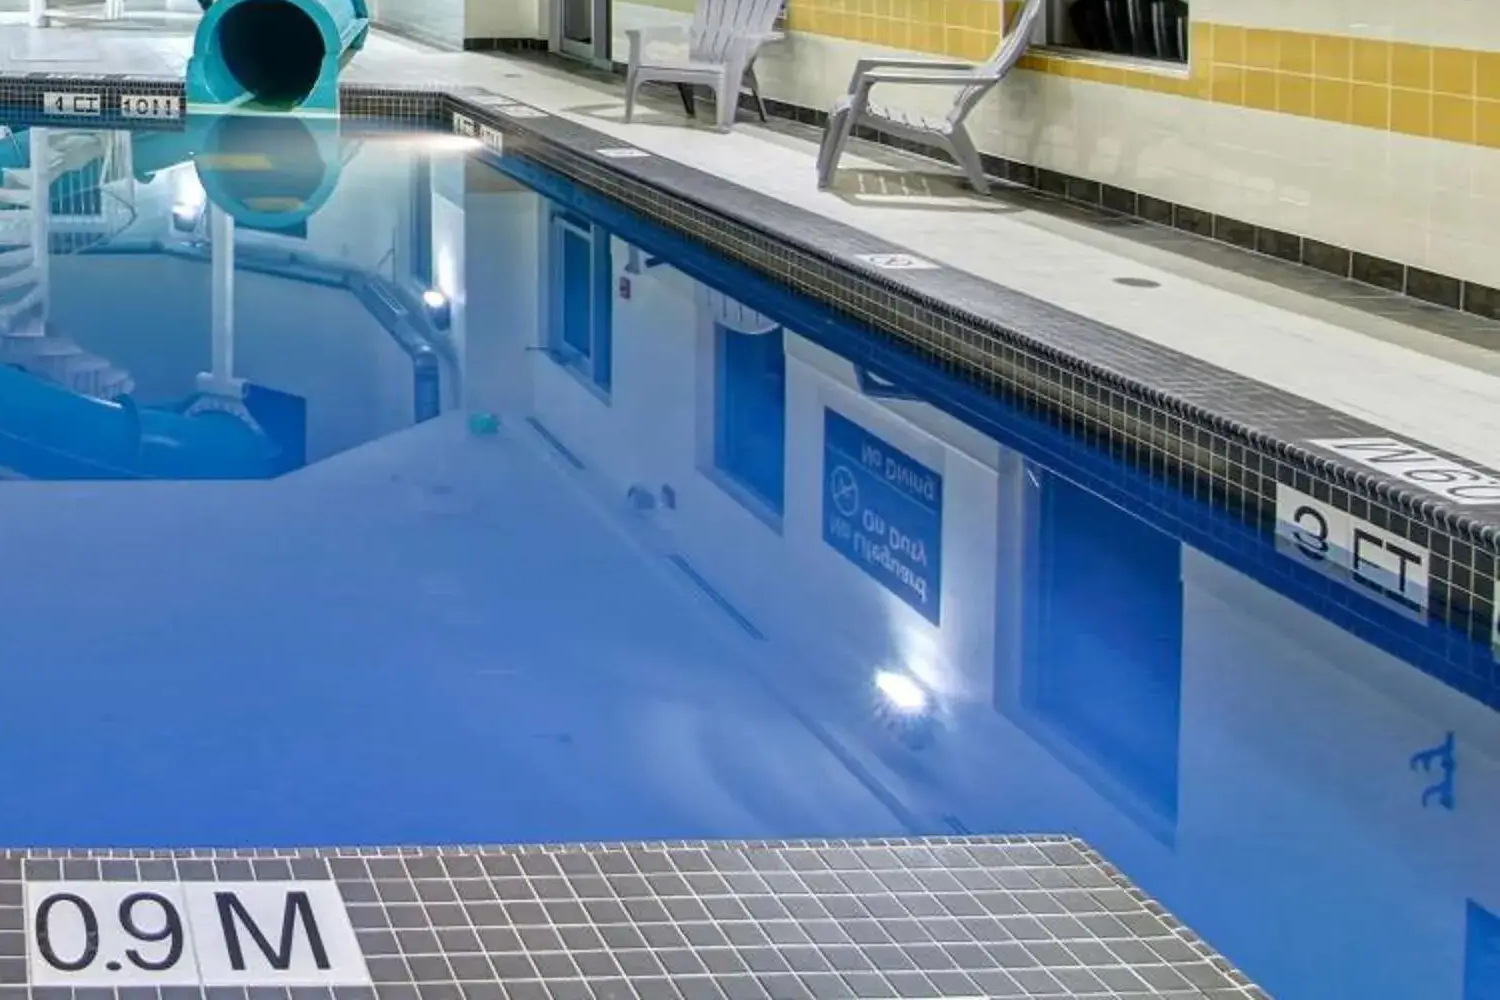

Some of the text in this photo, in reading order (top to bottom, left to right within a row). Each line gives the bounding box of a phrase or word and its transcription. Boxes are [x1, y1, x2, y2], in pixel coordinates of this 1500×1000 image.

[1293, 505, 1329, 560] 3
[35, 891, 331, 971] 0.9 M
